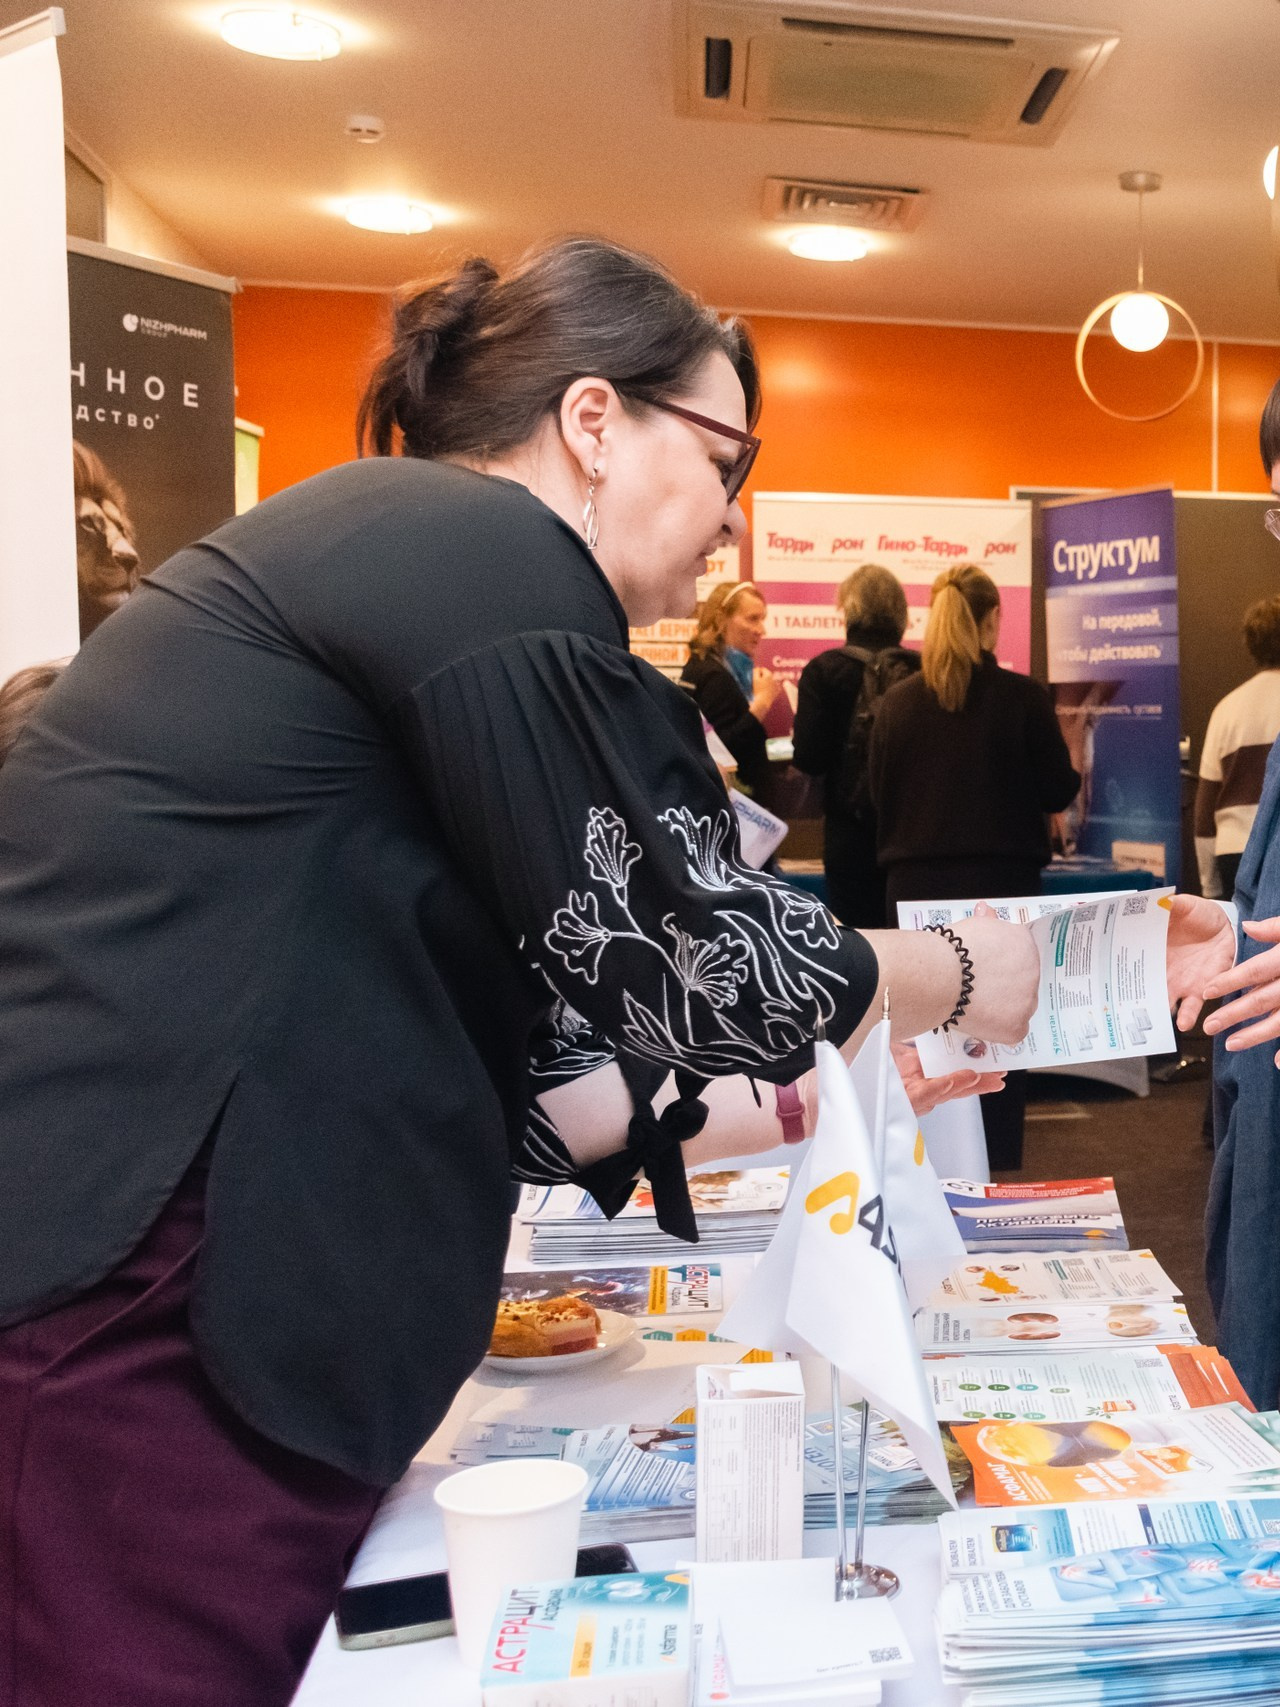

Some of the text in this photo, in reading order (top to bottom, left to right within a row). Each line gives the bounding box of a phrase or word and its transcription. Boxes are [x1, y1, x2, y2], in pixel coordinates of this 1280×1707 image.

[140, 317, 208, 340] NIZHPHARM
[1053, 535, 1160, 580] Структум
[1047, 1014, 1059, 1047] Ракстан
[1105, 1012, 1117, 1049] Бексист
[986, 1462, 1029, 1501] АСФАМАГ
[541, 1588, 564, 1621] Асфарма
[492, 1588, 548, 1674] АСТРАЦИТ
[660, 1624, 678, 1657] Asfarma
